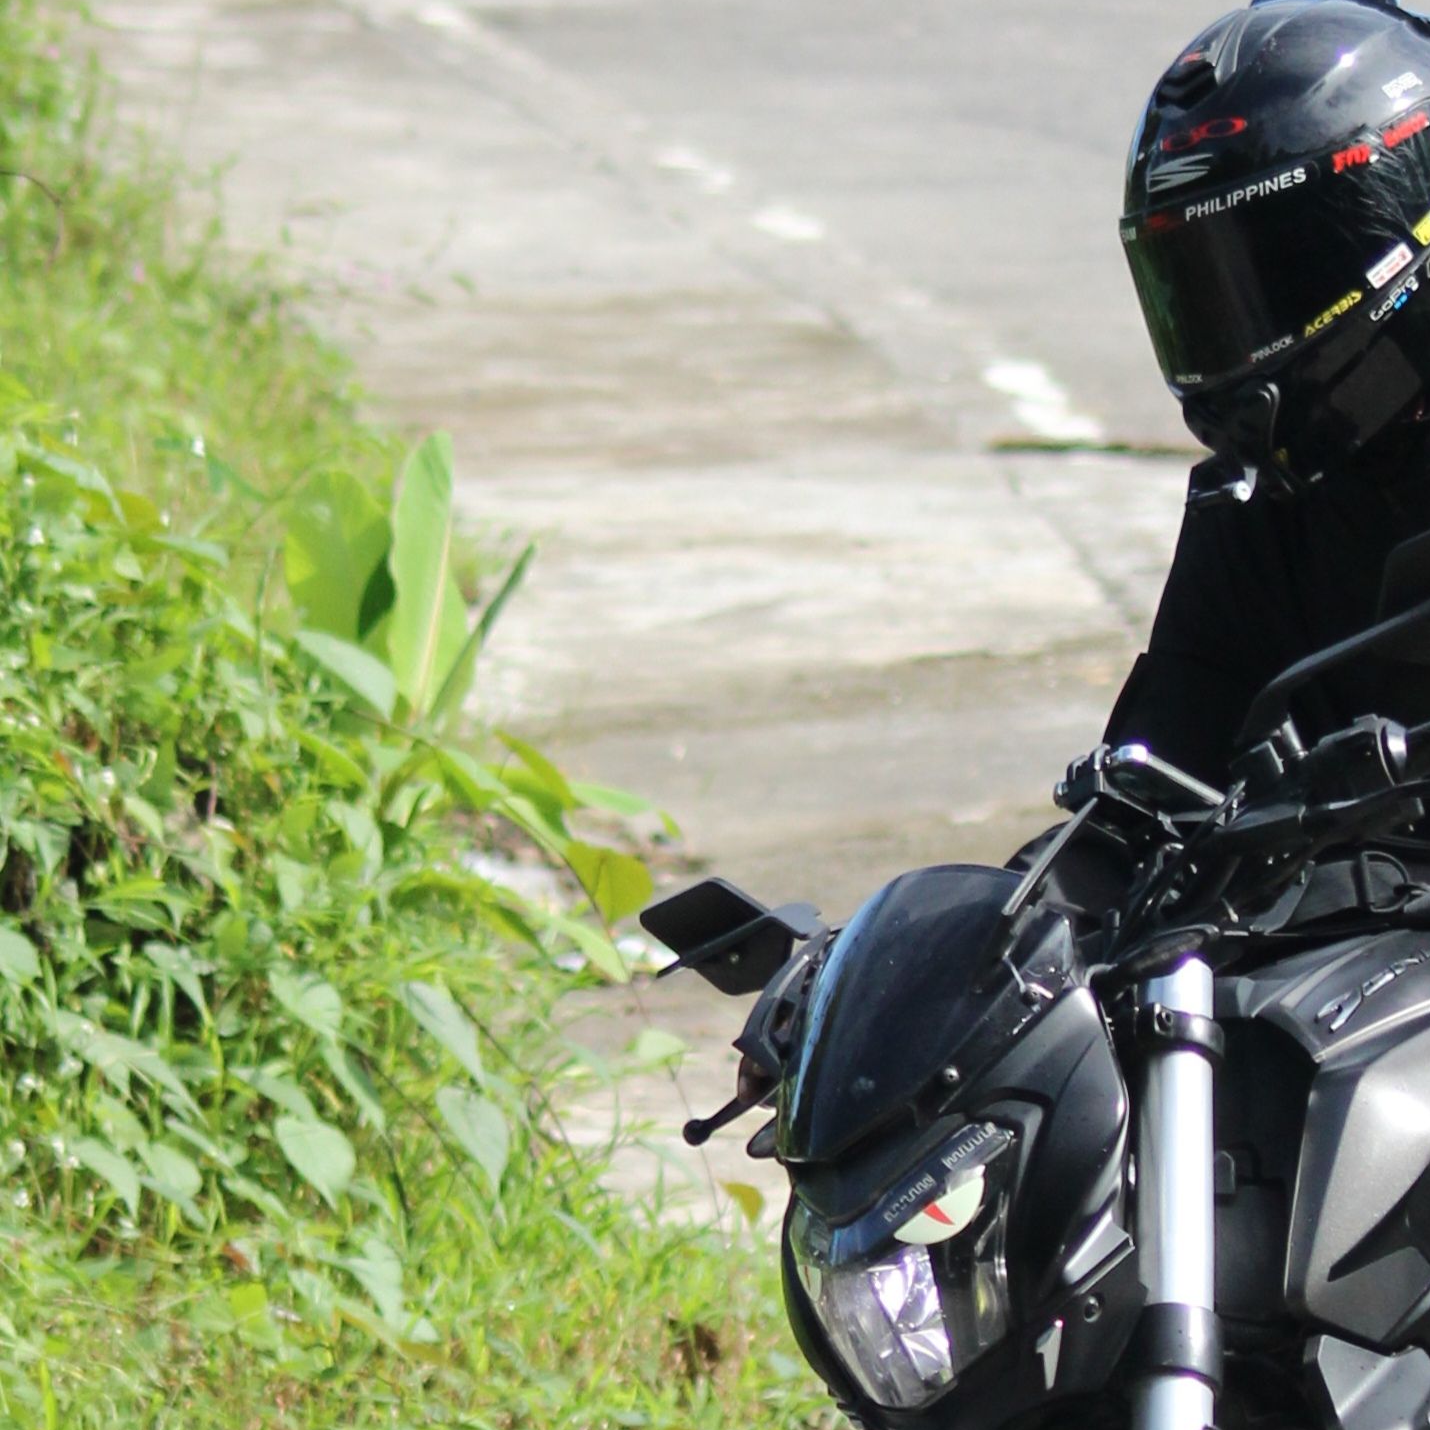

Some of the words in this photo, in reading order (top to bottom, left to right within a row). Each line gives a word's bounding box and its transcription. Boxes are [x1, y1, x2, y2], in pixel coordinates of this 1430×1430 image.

[1185, 167, 1307, 222] PHILIPPINES
[1304, 289, 1363, 338] ACERBIS
[1370, 276, 1416, 321] GoPro
